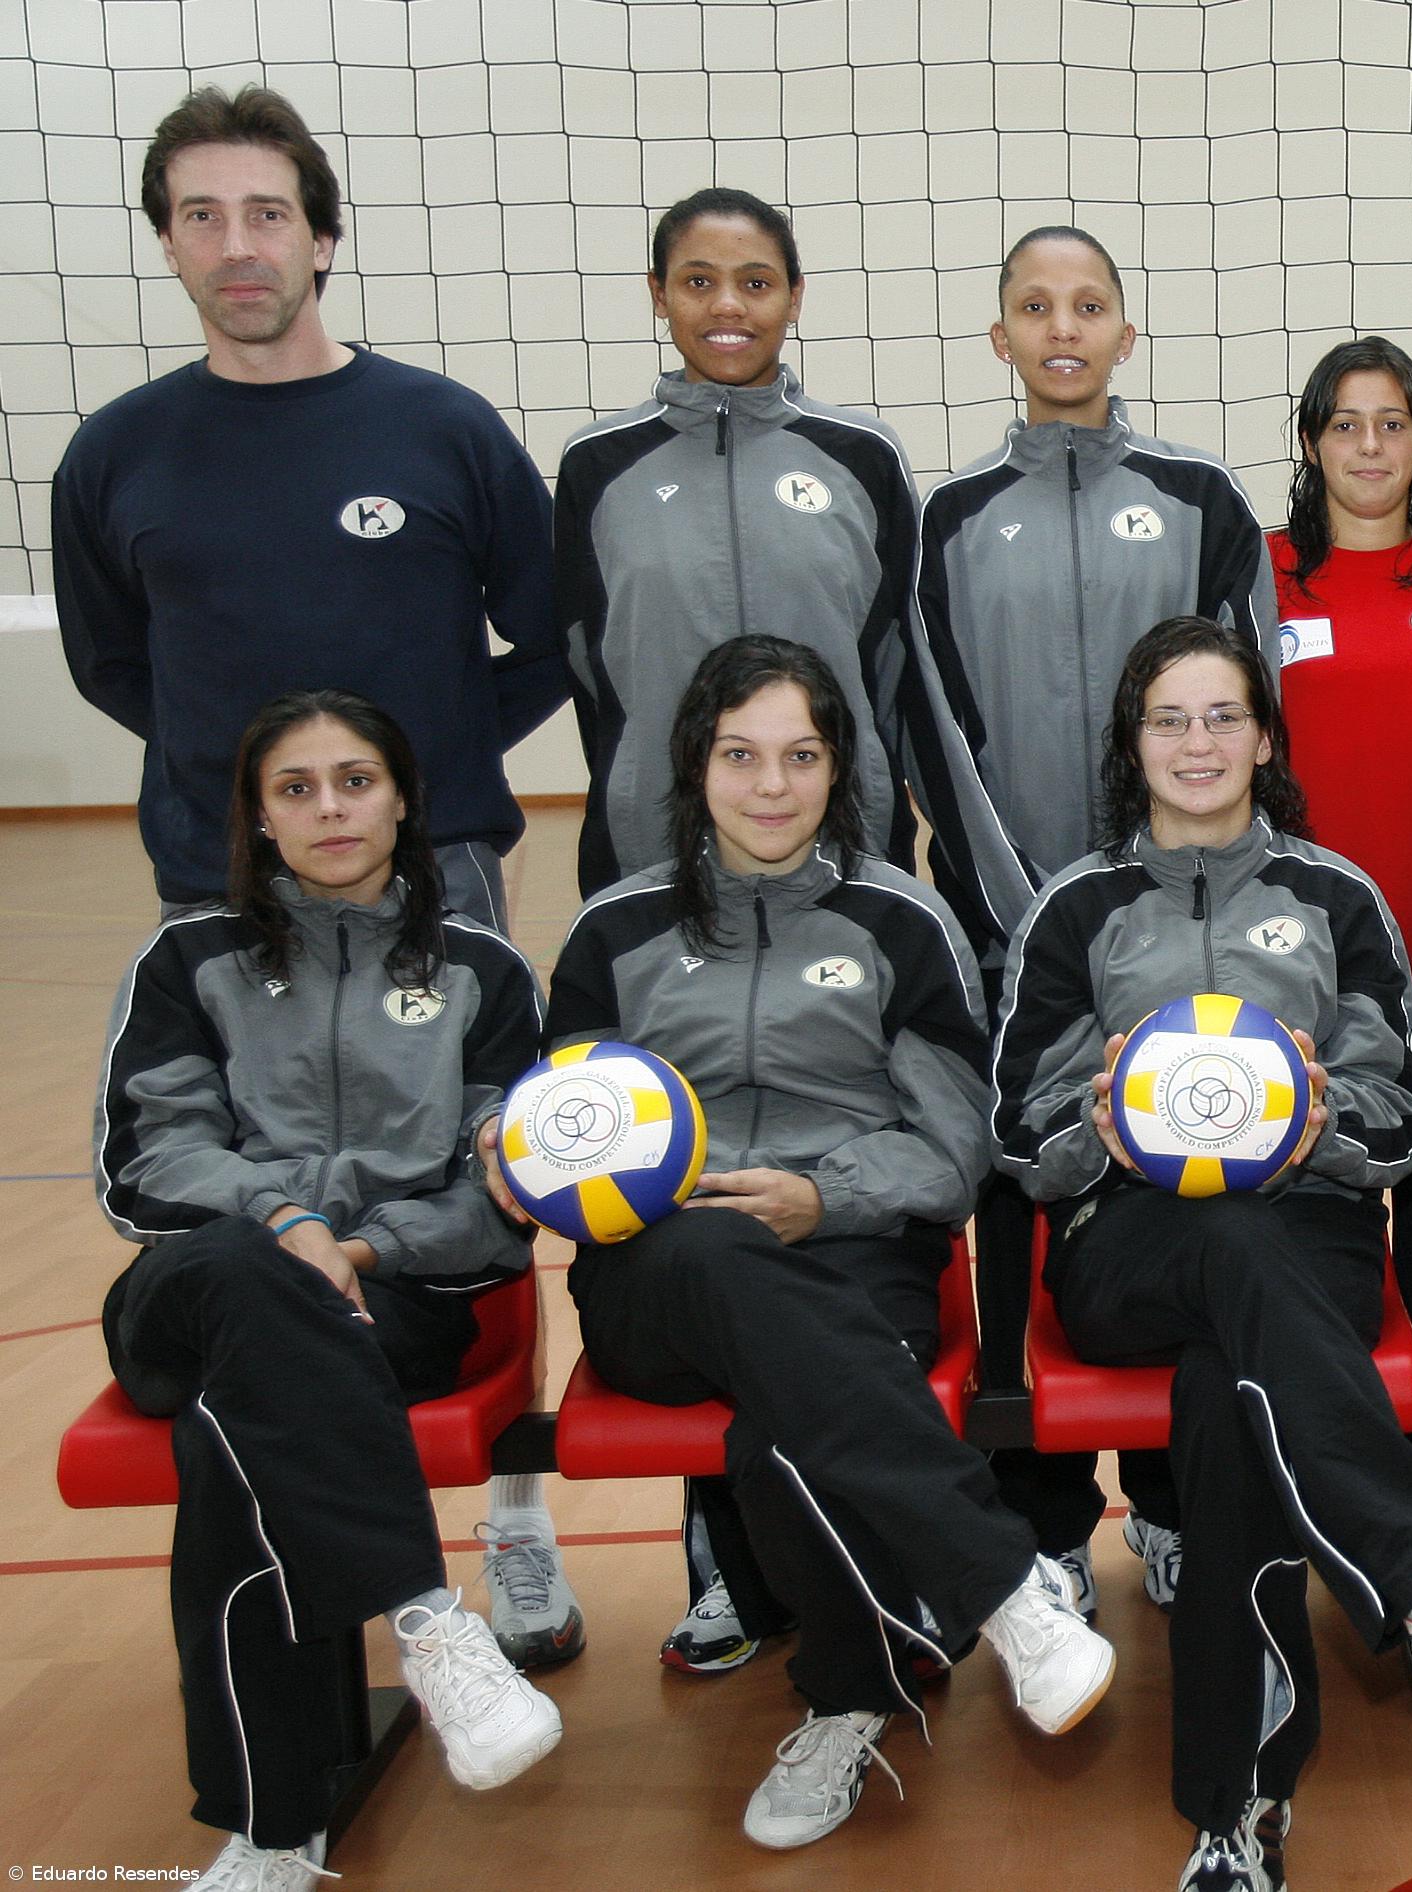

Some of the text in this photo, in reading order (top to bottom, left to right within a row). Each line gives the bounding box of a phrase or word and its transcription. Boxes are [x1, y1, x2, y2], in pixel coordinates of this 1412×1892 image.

[542, 1153, 576, 1172] WORLD
[578, 1112, 631, 1171] COMPETITIONS
[1165, 1120, 1196, 1147] WORLD
[1197, 1107, 1263, 1150] COMPETITIONS
